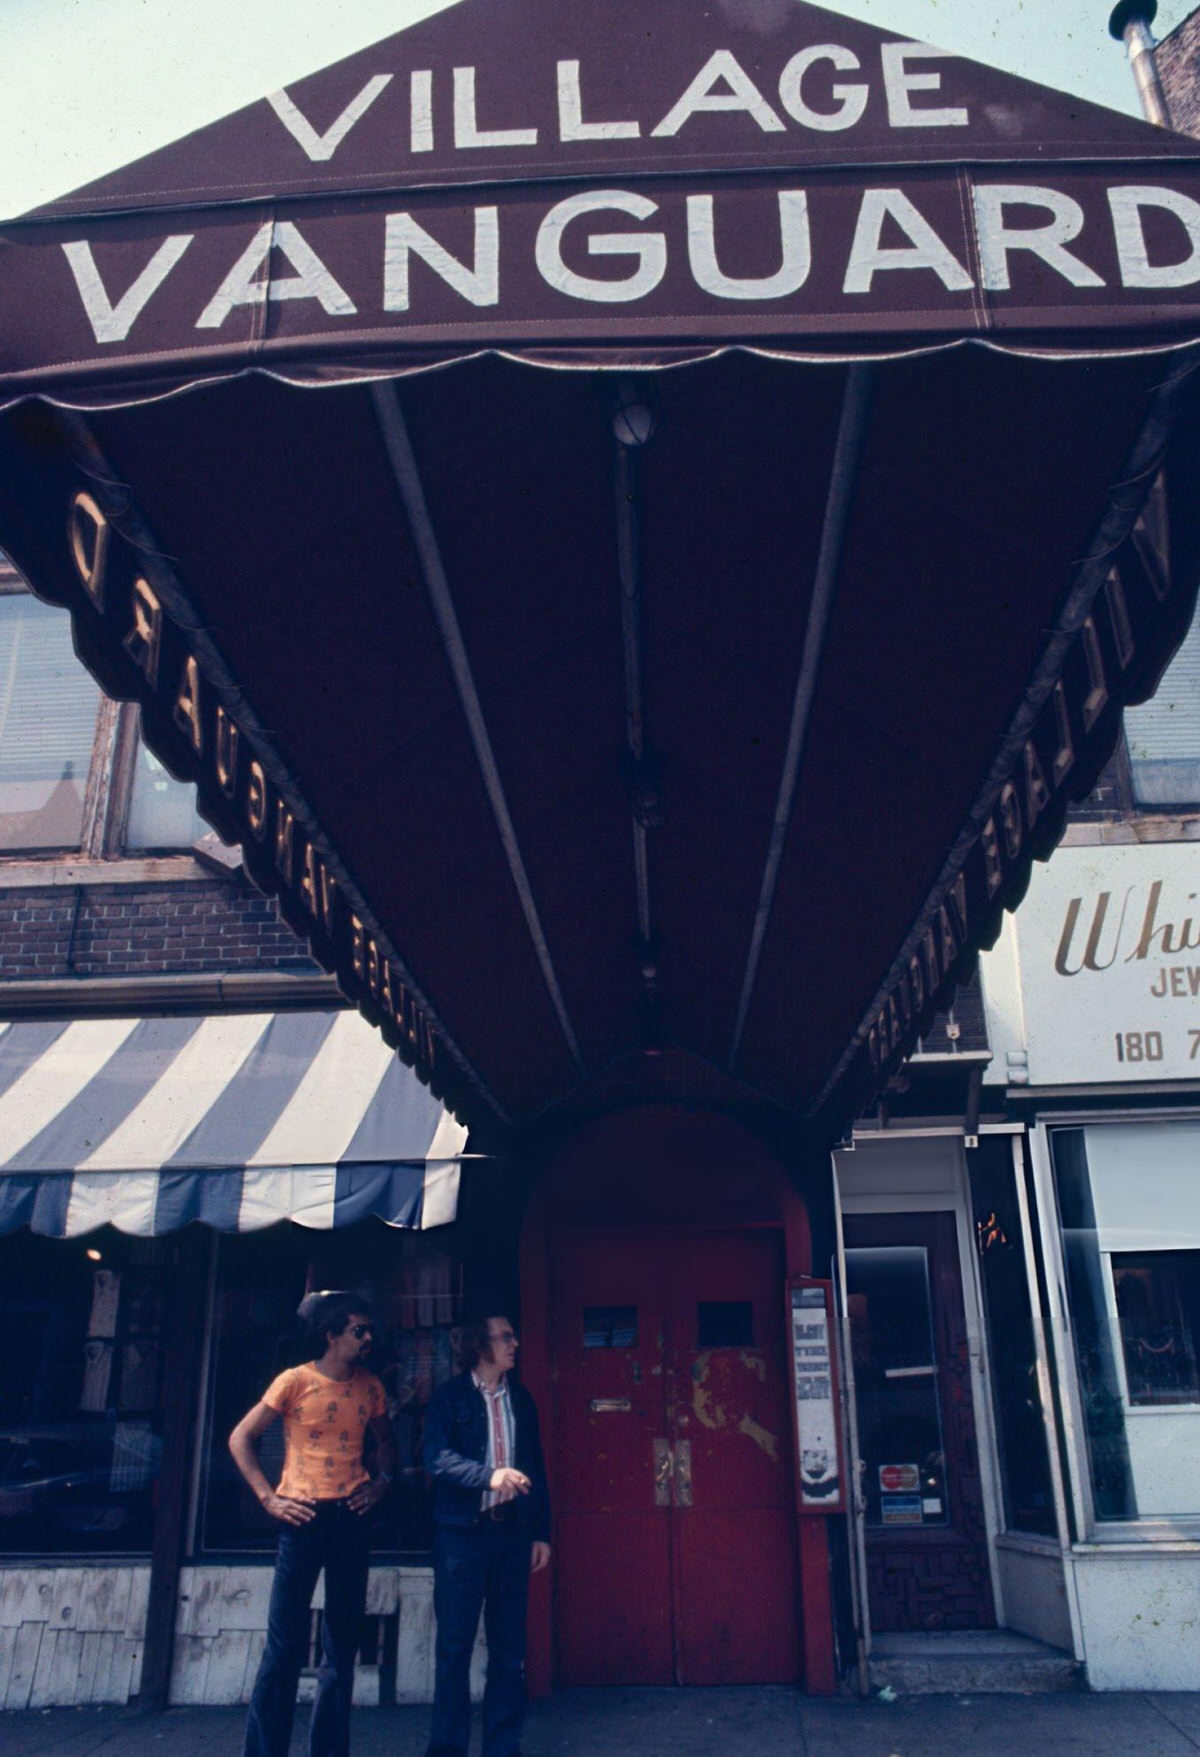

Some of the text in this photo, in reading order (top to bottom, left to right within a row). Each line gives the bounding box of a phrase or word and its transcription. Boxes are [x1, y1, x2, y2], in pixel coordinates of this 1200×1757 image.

[266, 41, 970, 162] VILLAGE
[62, 184, 1200, 344] VANGUARD
[1055, 880, 1200, 977] Whi
[1115, 1031, 1163, 1062] 180
